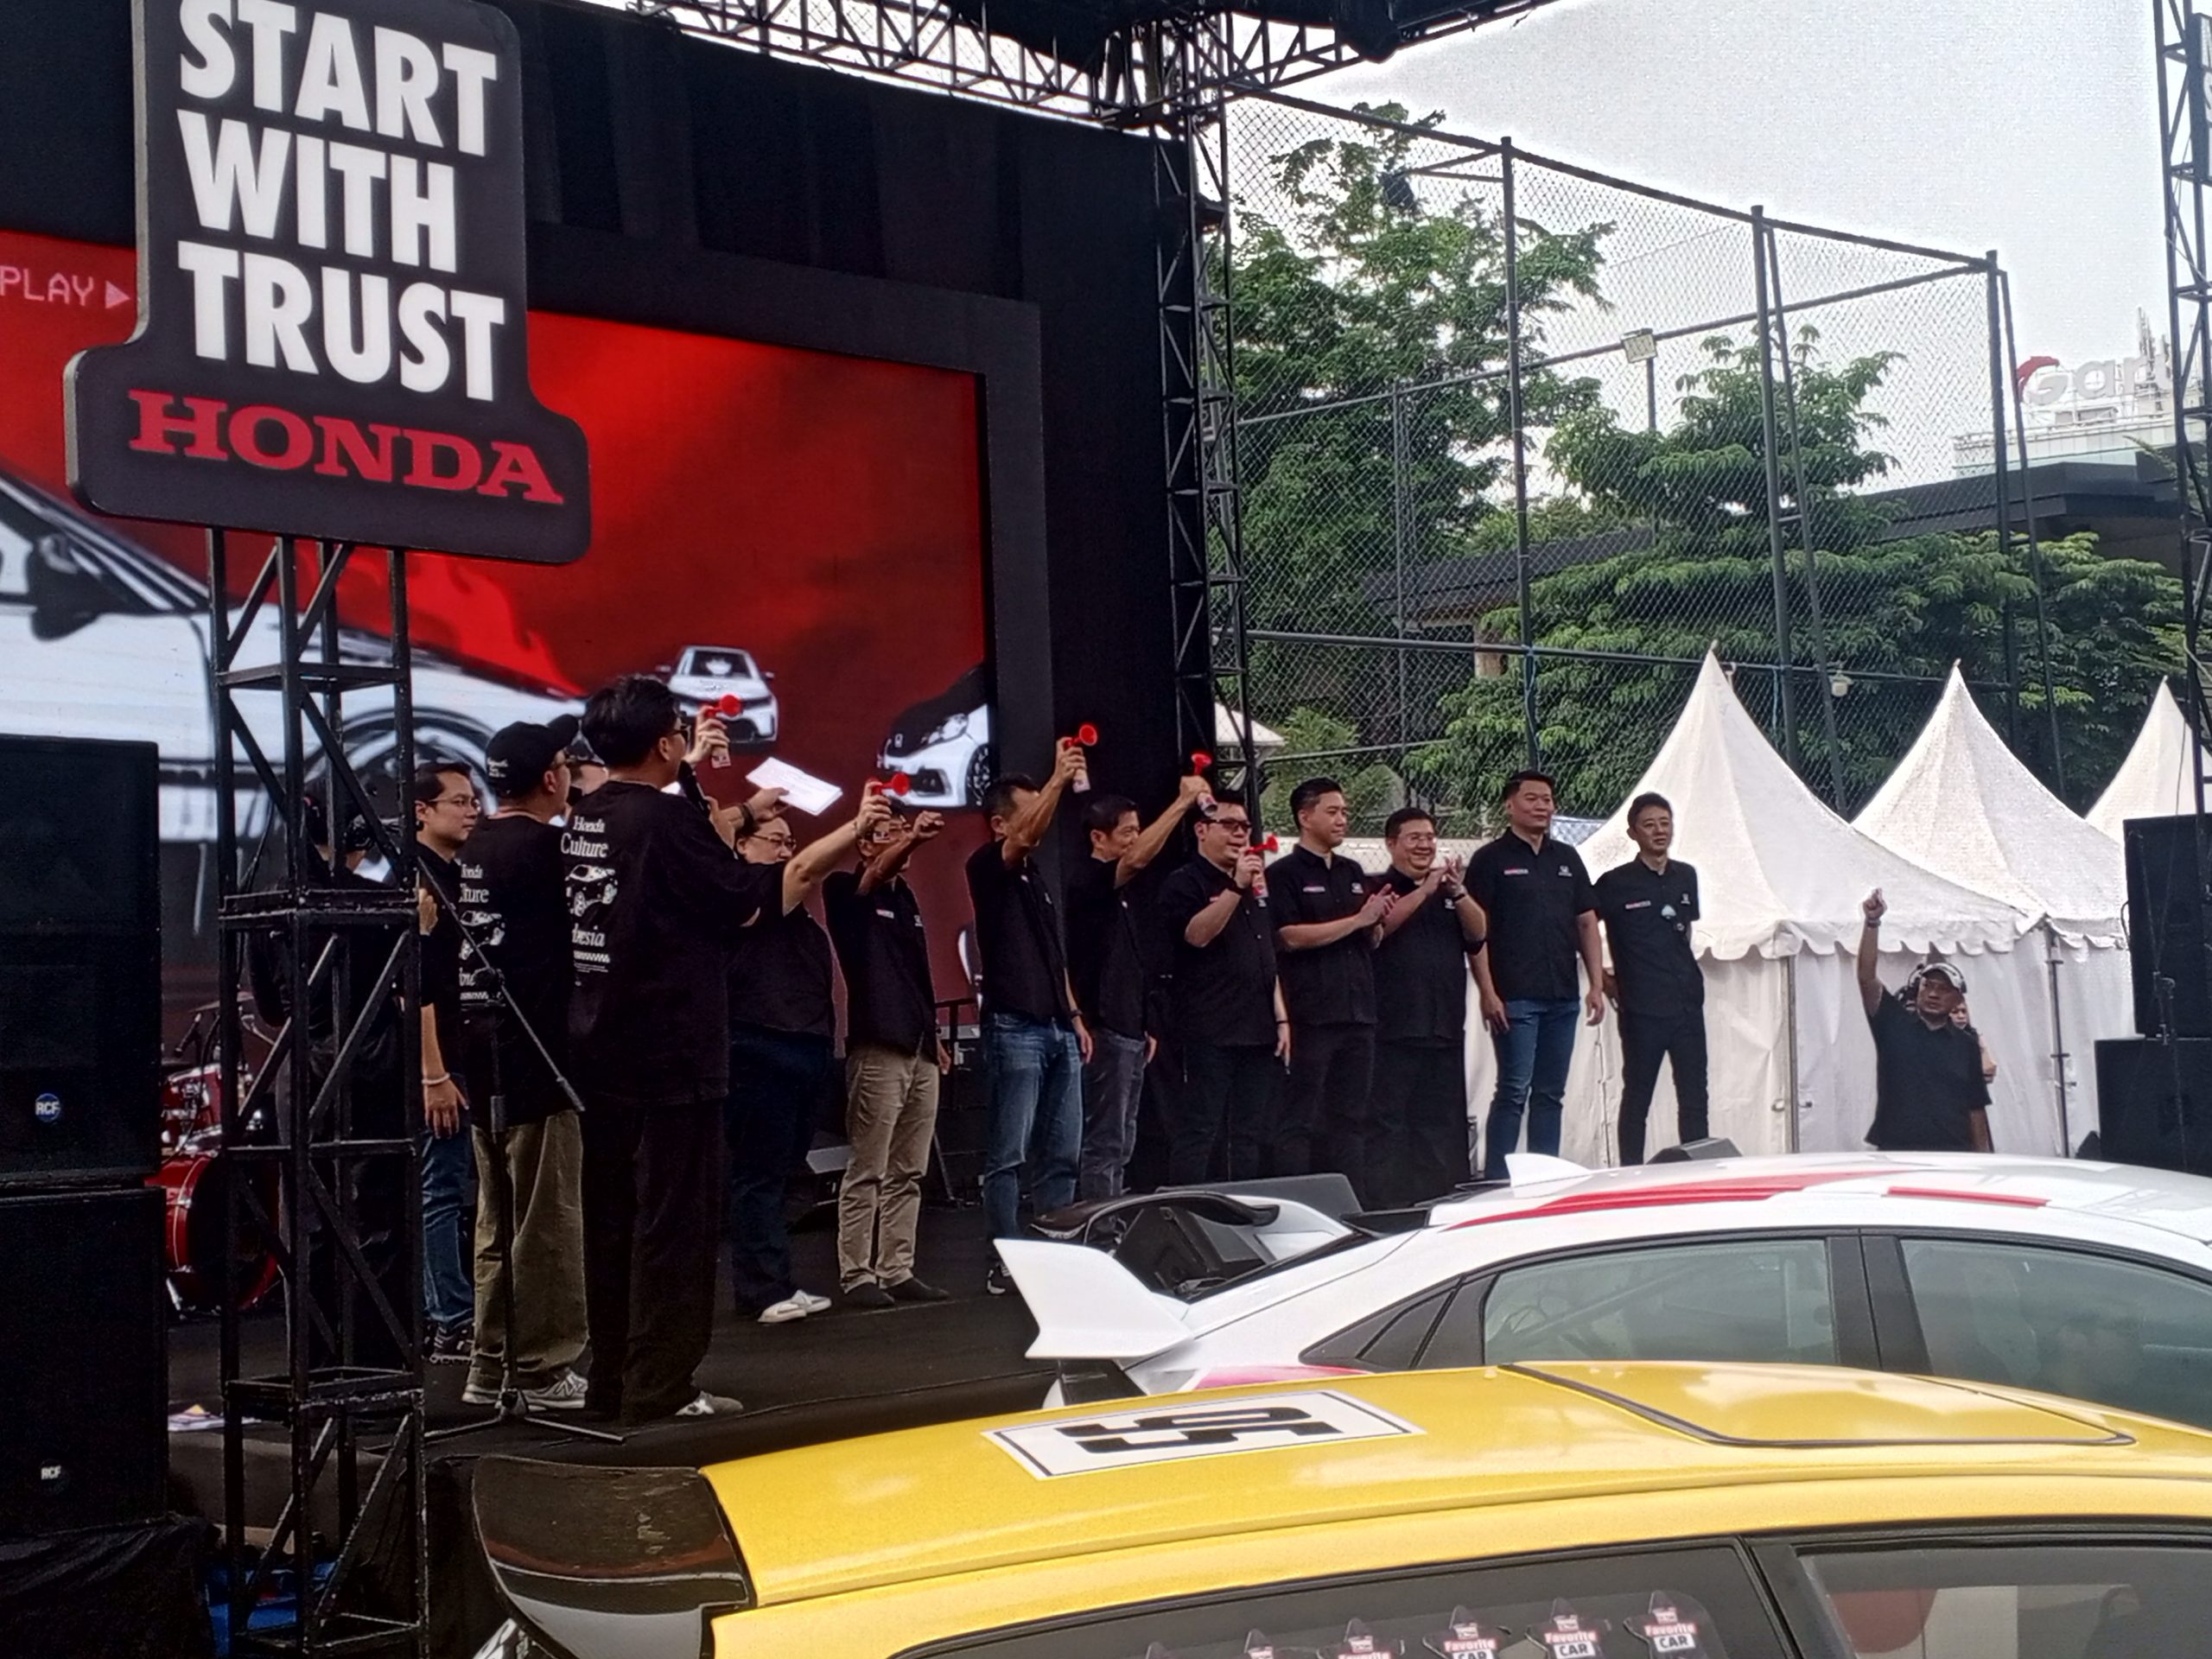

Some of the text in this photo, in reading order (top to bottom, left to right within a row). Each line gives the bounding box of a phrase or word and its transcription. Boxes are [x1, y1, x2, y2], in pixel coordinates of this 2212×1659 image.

[180, 0, 498, 157] START
[176, 109, 457, 273] WITH
[0, 265, 95, 307] PLAY
[177, 240, 505, 402] TRUST
[128, 389, 564, 505] HONDA
[560, 832, 609, 858] Culture
[35, 1101, 60, 1116] RCF
[1558, 1642, 1589, 1657] CAR
[1658, 1634, 1689, 1649] CAR
